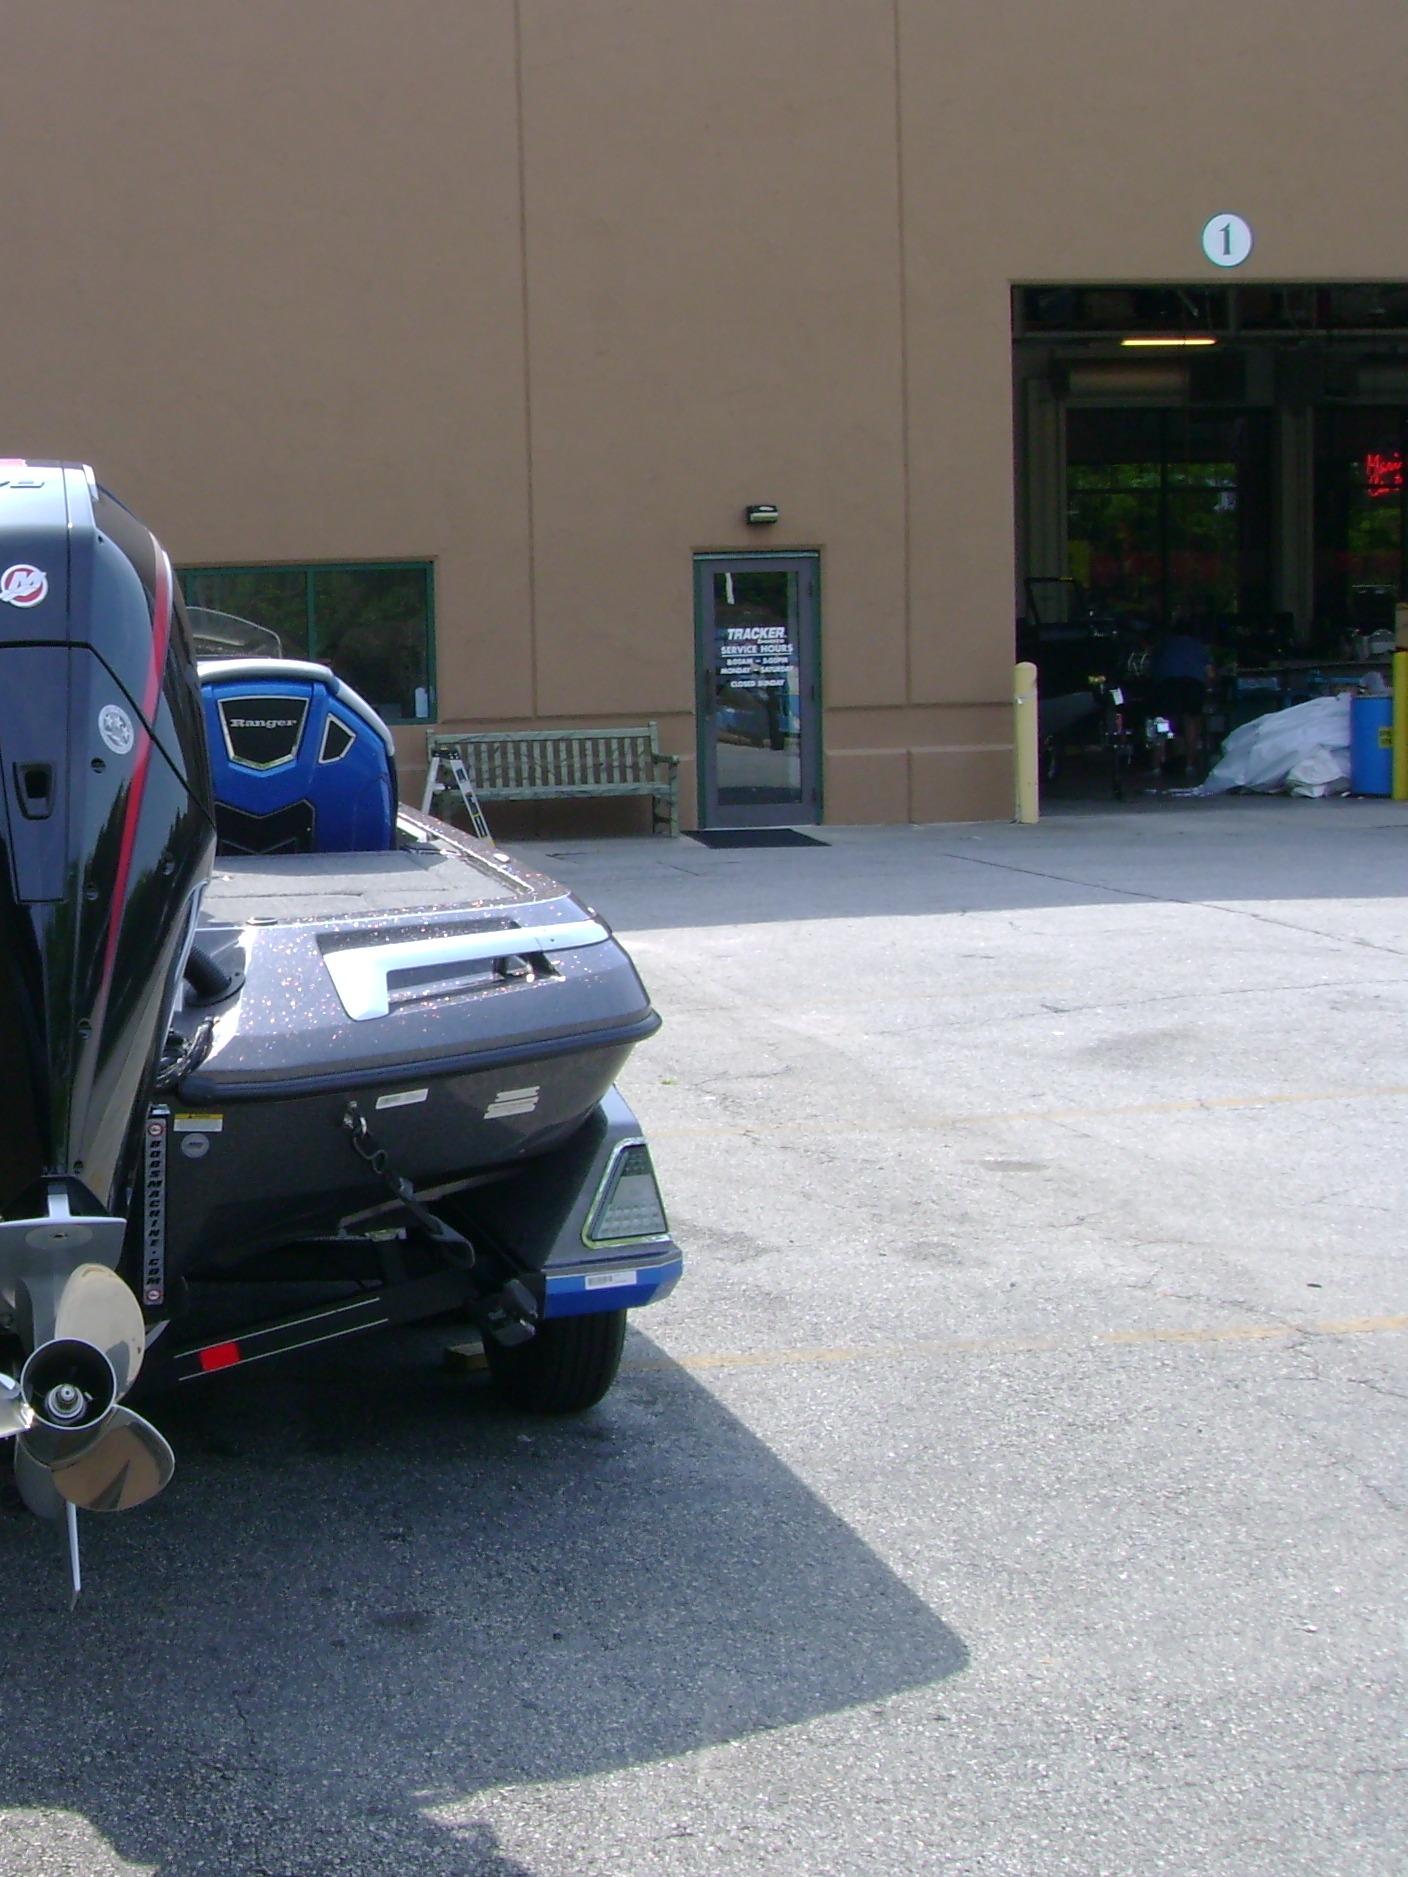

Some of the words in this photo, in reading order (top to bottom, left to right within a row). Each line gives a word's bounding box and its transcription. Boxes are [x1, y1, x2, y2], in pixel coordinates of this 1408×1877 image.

[1217, 222, 1232, 256] 1
[727, 627, 785, 640] TRACKER
[720, 645, 758, 655] SERVICE
[760, 643, 794, 653] HOURS
[730, 680, 756, 688] CLOSED
[757, 679, 786, 687] SUNDAY
[230, 718, 297, 729] Ranger
